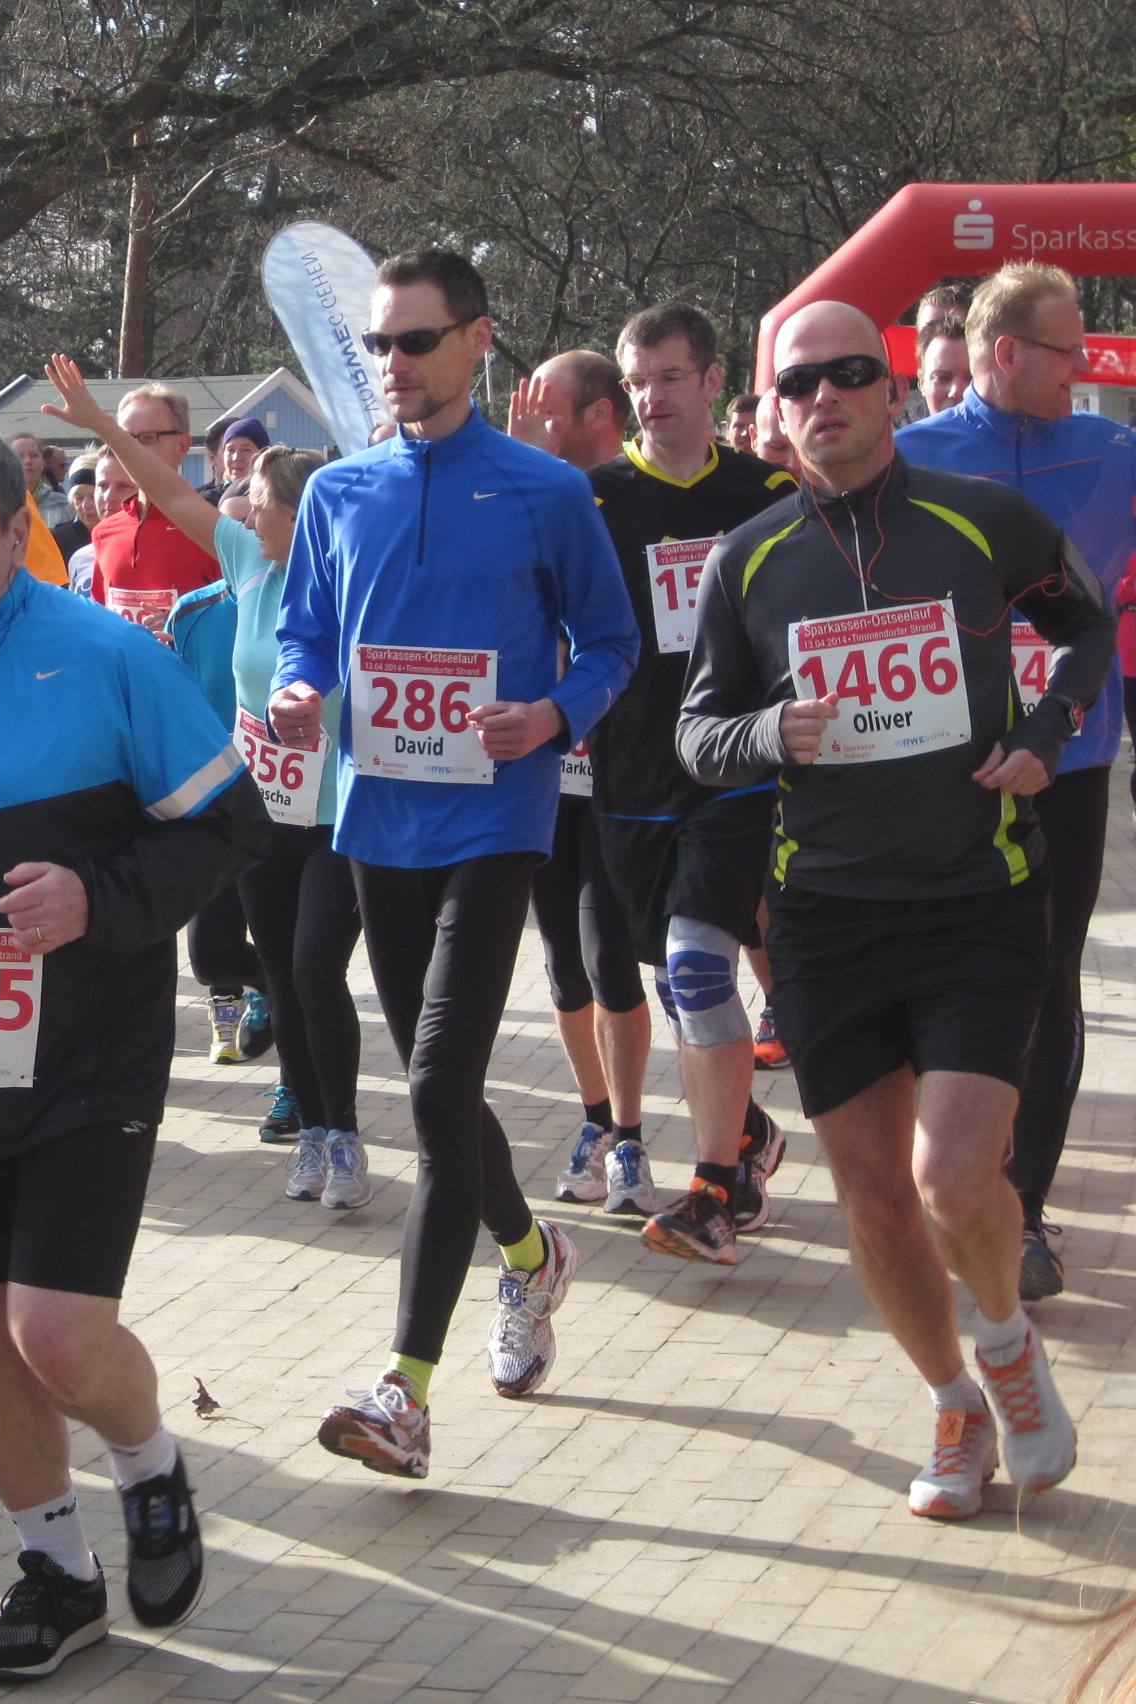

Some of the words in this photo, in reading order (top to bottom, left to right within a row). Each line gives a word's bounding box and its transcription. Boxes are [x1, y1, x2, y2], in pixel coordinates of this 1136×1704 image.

[804, 606, 932, 638] Sparkassen-Ostseelauf
[804, 636, 847, 650] 13.04.2014
[852, 627, 908, 643] Timmendorfer
[909, 622, 937, 635] Strand
[364, 662, 402, 672] 13.04.2014
[406, 664, 454, 675] Timmendorfer
[456, 667, 480, 676] Strand
[366, 648, 478, 664] Sparkassen-Ostseelauf
[797, 636, 958, 707] 1466
[1010, 650, 1047, 694] 4
[371, 676, 472, 734] 286
[853, 710, 914, 734] Oliver
[395, 735, 444, 757] David
[842, 743, 876, 753] Sparkasse
[244, 735, 305, 791] 356
